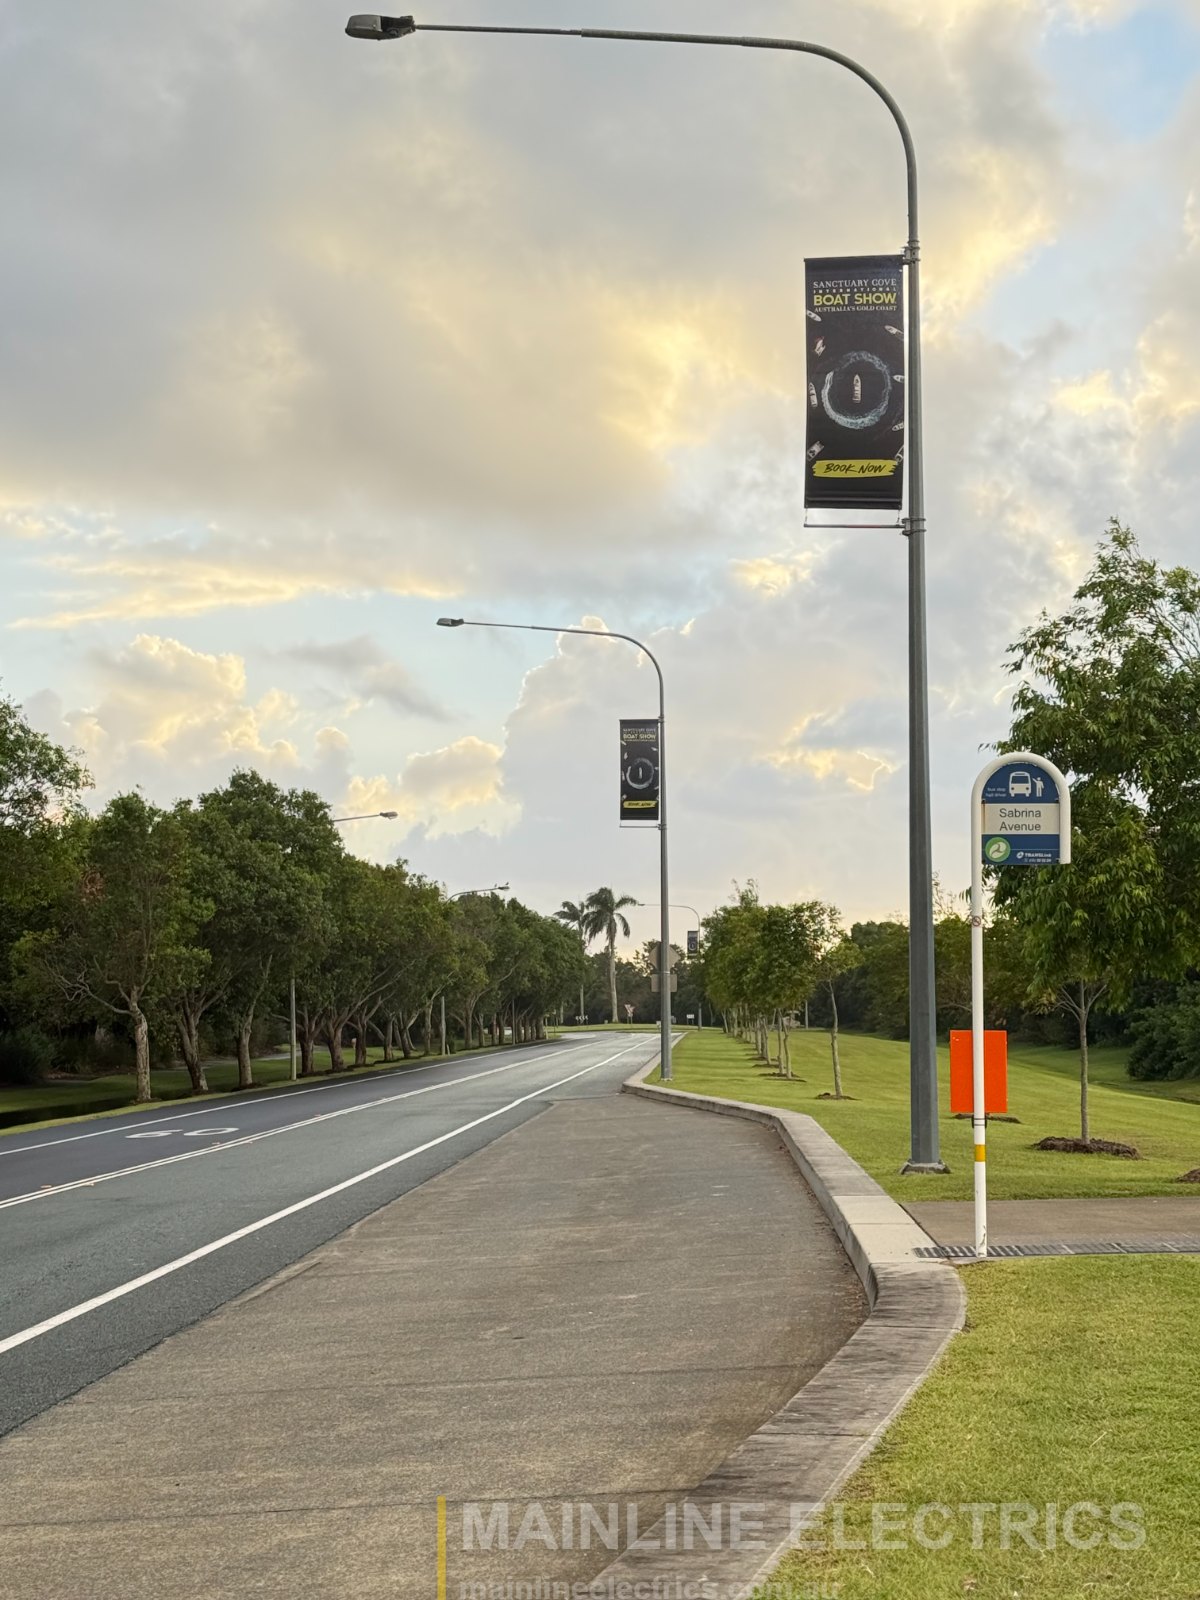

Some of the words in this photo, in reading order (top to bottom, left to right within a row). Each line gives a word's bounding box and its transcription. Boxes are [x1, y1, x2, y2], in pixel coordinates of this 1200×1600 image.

[813, 279, 869, 288] SANCTUARY
[872, 278, 897, 286] COVE
[813, 294, 851, 306] BOAT
[854, 293, 897, 305] SHOW
[823, 463, 857, 473] BOOK
[857, 463, 887, 473] NOW
[999, 808, 1041, 818] Sabrina
[999, 821, 1041, 831] Avenue
